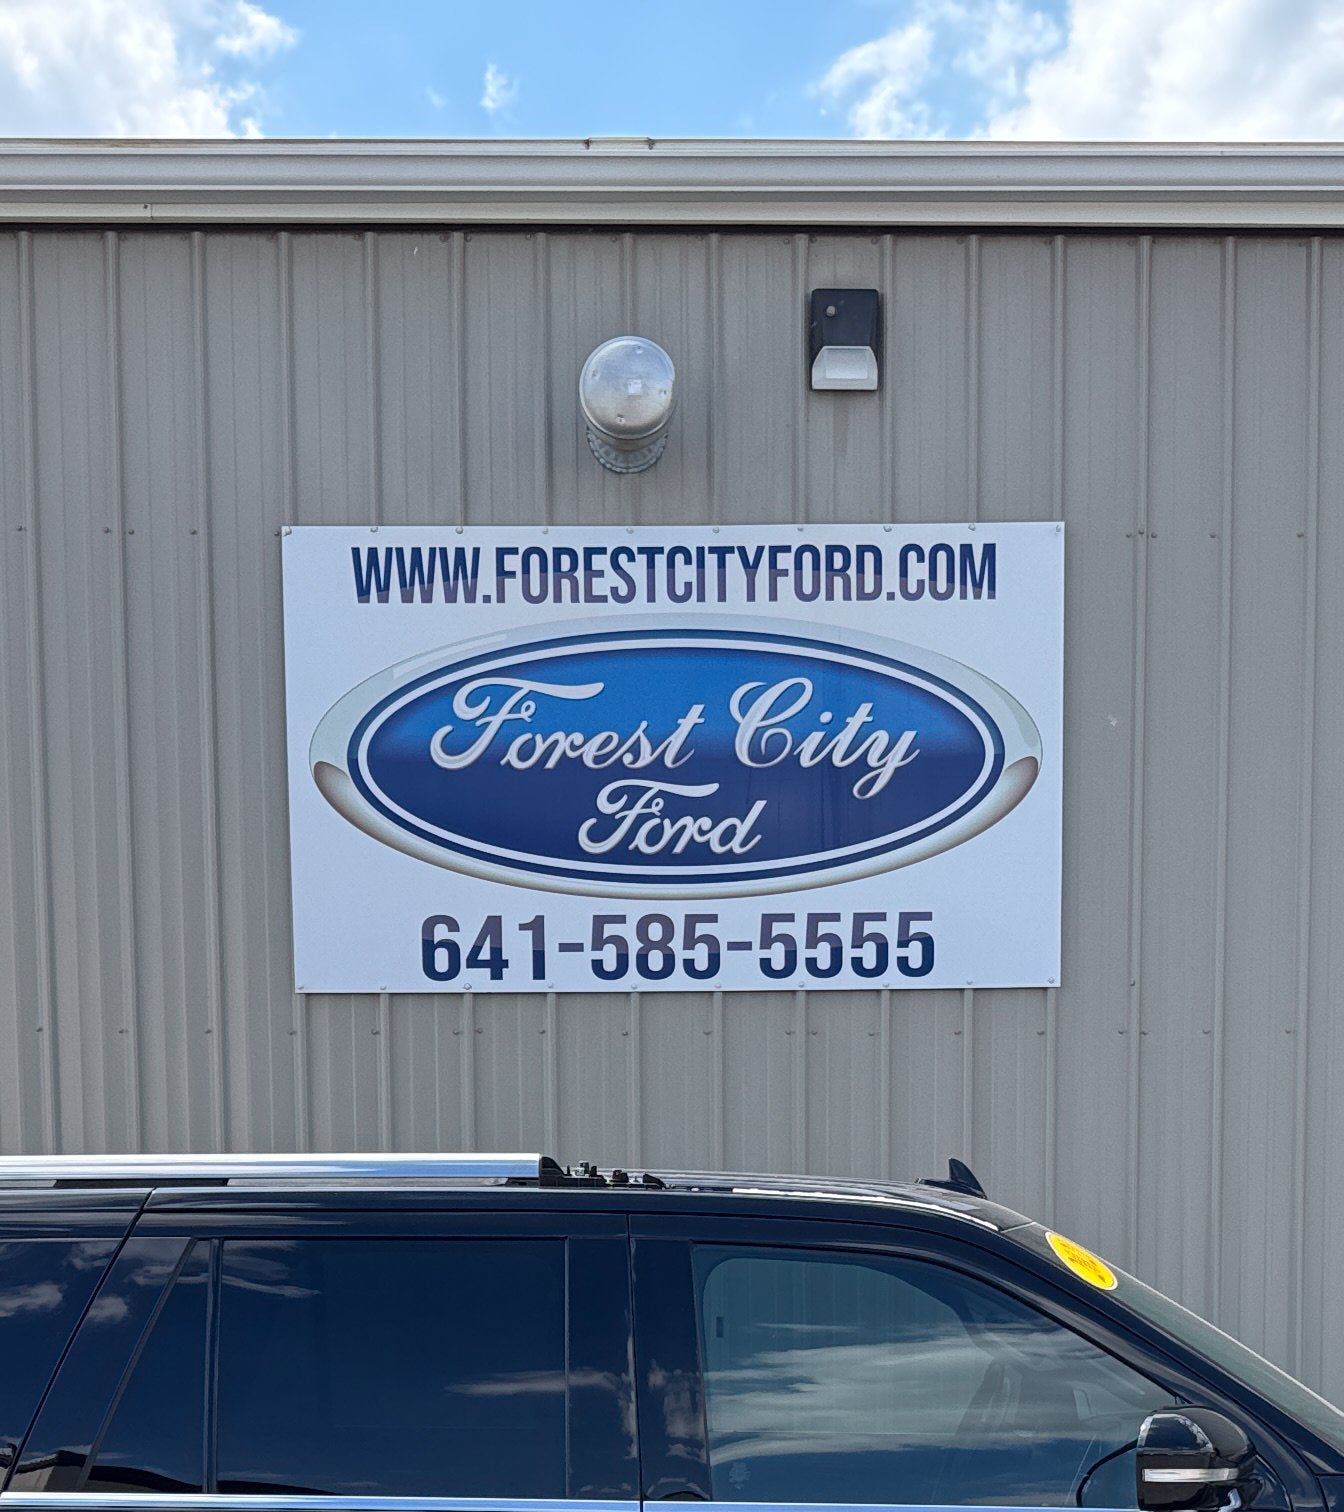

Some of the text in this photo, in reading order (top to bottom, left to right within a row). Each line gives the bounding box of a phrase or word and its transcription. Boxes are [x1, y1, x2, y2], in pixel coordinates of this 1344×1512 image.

[351, 543, 997, 604] WWW.FORESTCITYFORD.COM
[428, 676, 920, 798] Forest City
[577, 778, 767, 855] Ford
[420, 911, 935, 982] 641-585-5555
